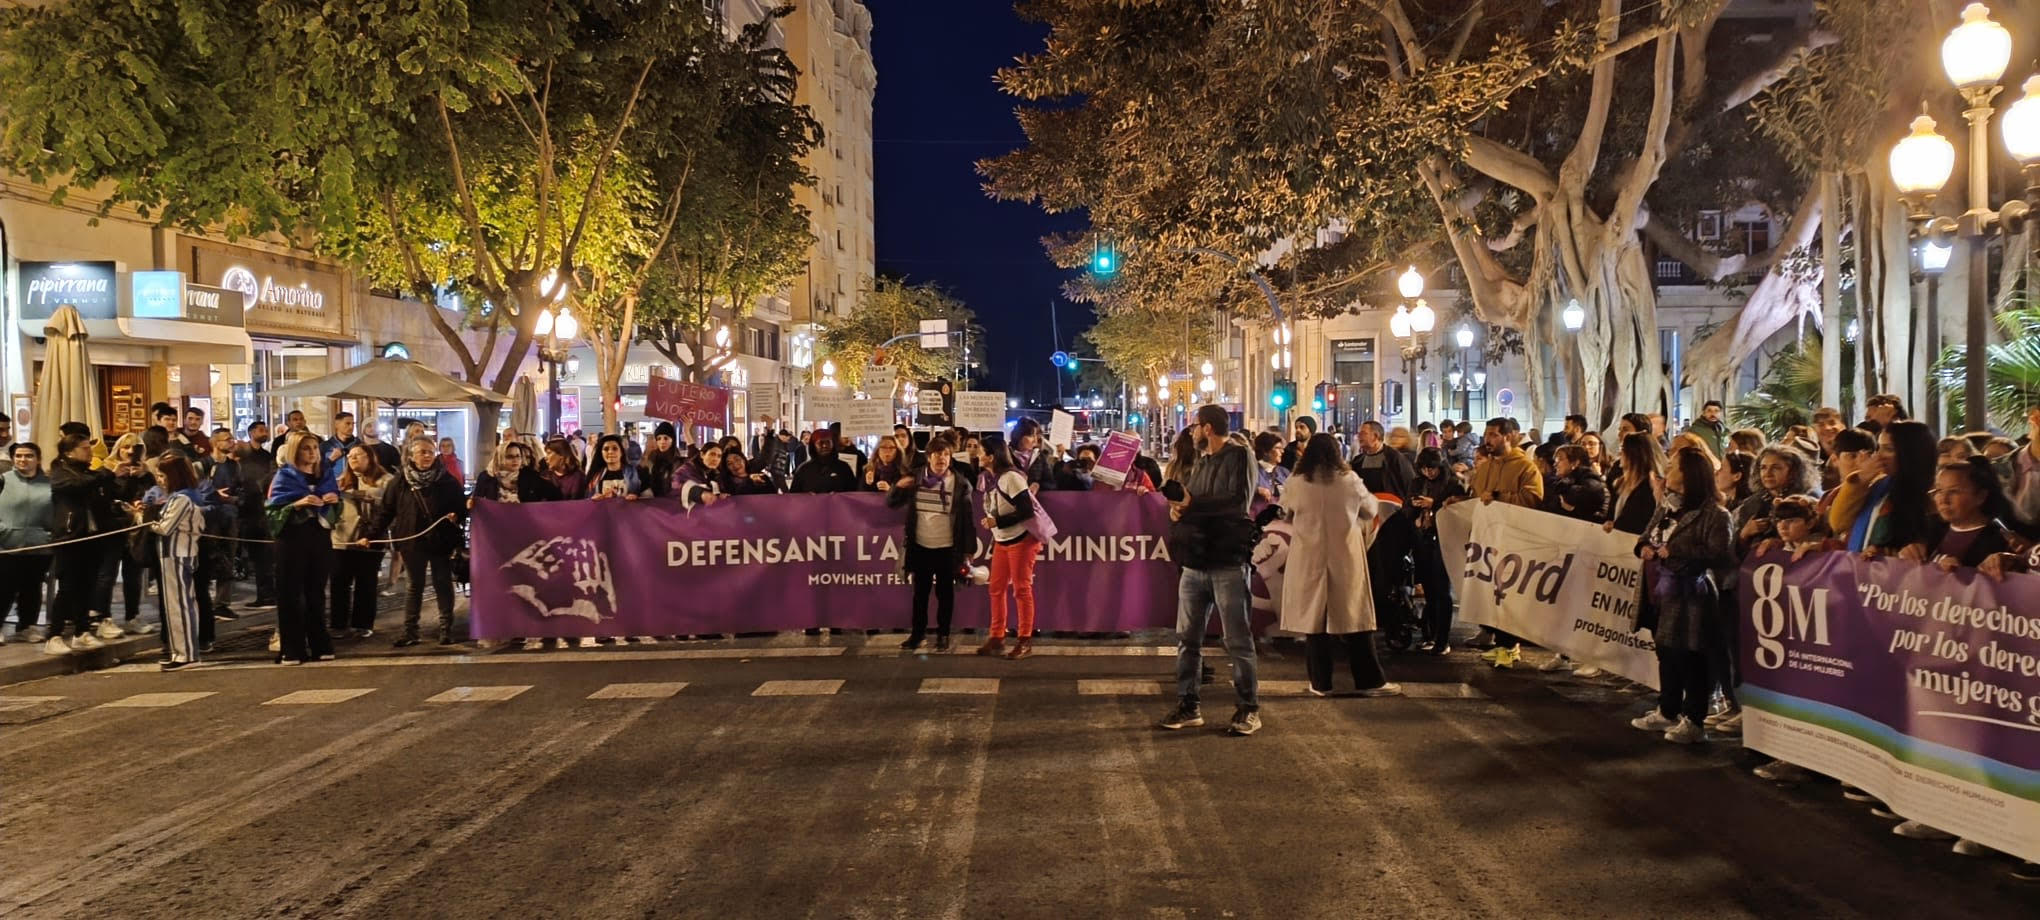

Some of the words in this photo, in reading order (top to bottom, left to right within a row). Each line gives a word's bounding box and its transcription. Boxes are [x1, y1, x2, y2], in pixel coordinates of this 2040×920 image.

[27, 277, 108, 304] pipirrana
[260, 275, 323, 308] Amorino
[657, 381, 715, 400] PUTERO
[667, 535, 846, 566] DEFENSANT
[808, 574, 882, 585] MOVIMENT
[1591, 591, 1612, 612] EN
[1900, 590, 1929, 617] los
[1932, 596, 2040, 639] derechos
[1573, 617, 1657, 651] protagonistes
[1888, 629, 1931, 653] por
[1931, 631, 1969, 662] los
[1788, 660, 1798, 668] DE
[1799, 662, 1812, 671] LAS
[1915, 668, 2023, 712] mujeres
